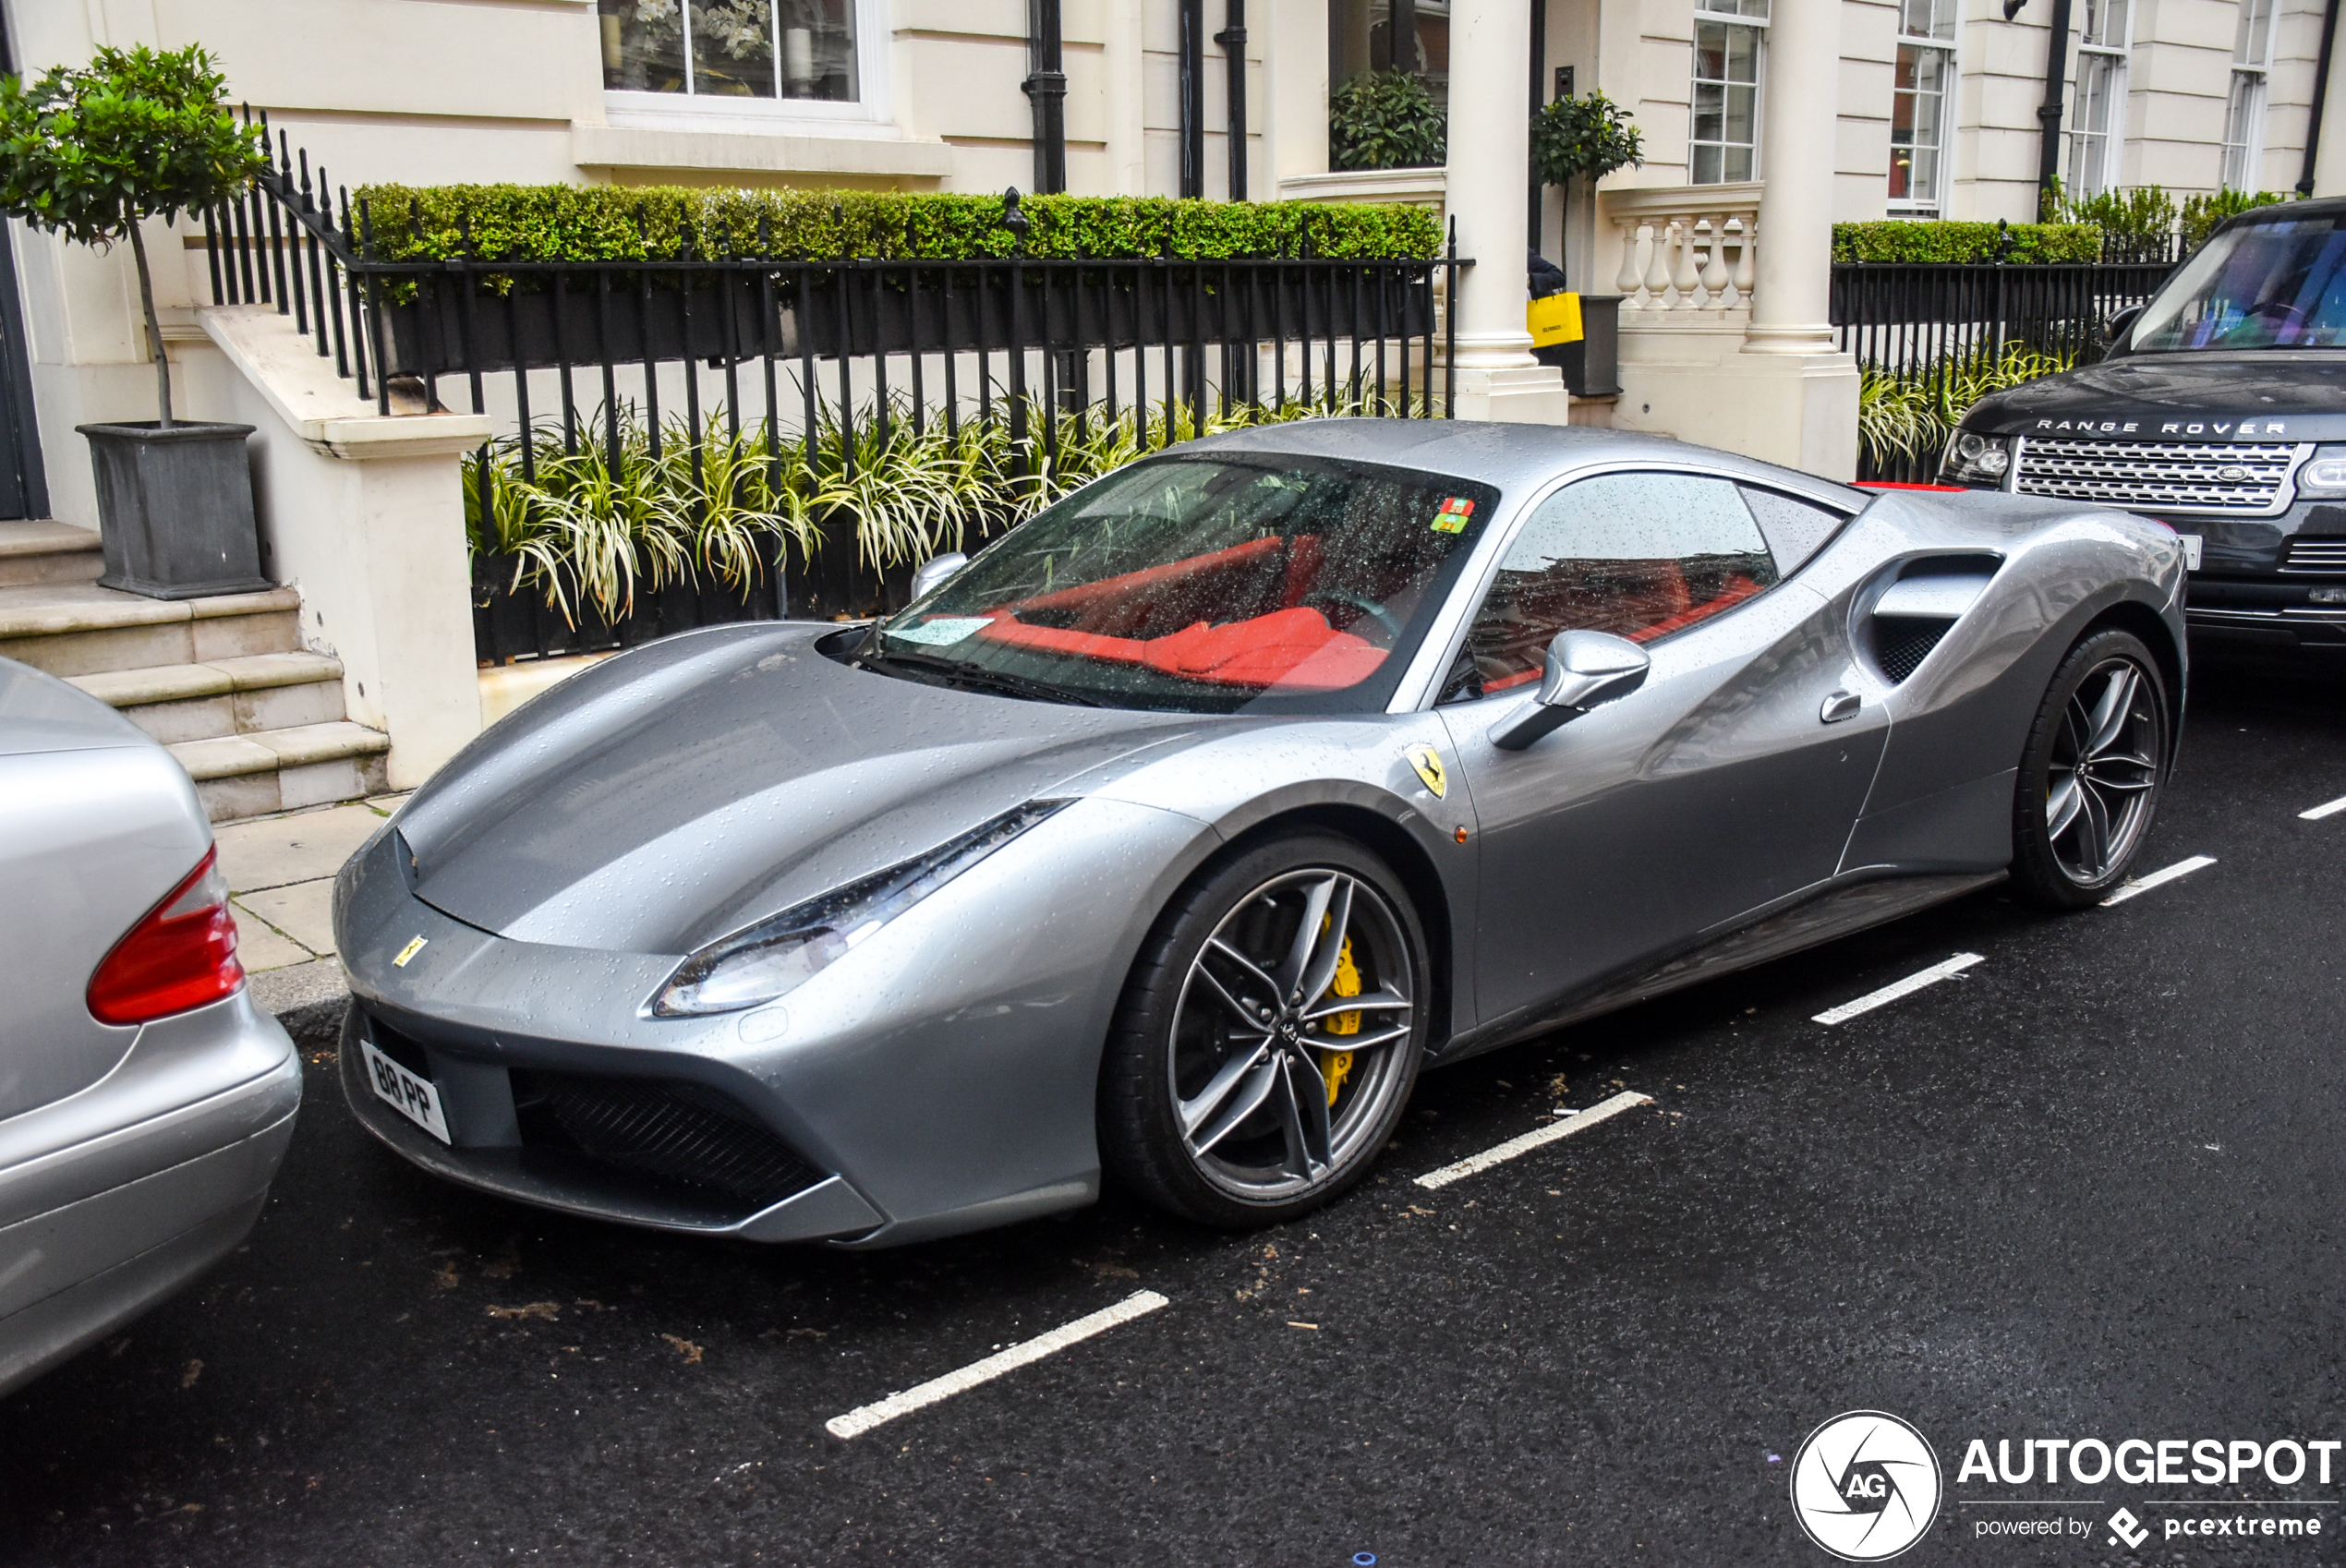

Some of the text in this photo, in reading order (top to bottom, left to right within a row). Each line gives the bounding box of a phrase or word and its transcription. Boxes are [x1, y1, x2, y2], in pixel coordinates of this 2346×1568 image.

[2037, 419, 2285, 435] RANGE ROVER
[373, 1055, 431, 1123] 88 PP
